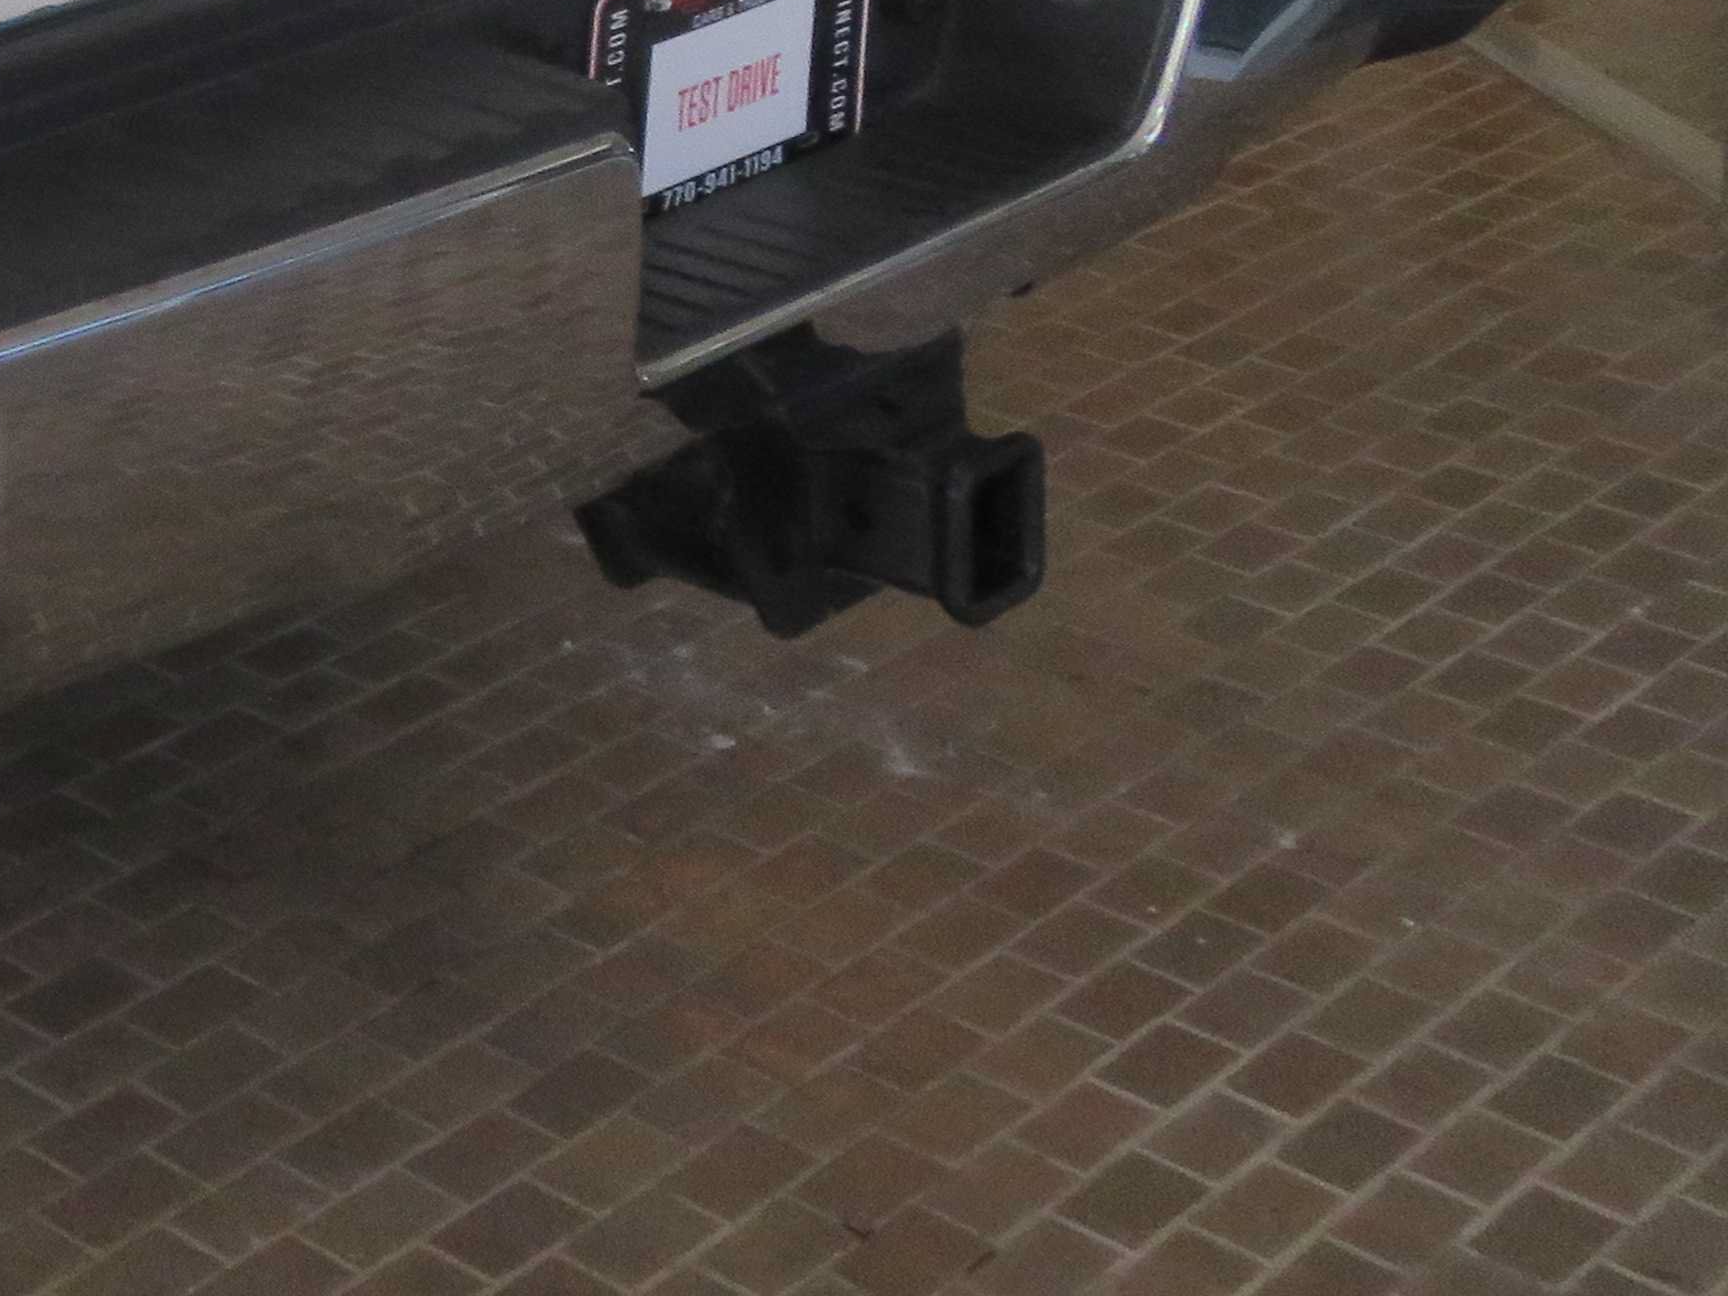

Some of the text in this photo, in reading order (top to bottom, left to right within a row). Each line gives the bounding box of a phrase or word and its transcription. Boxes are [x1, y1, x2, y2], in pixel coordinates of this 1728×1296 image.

[678, 51, 783, 133] TEST DRIVE
[661, 144, 784, 211] 770-941-1194
